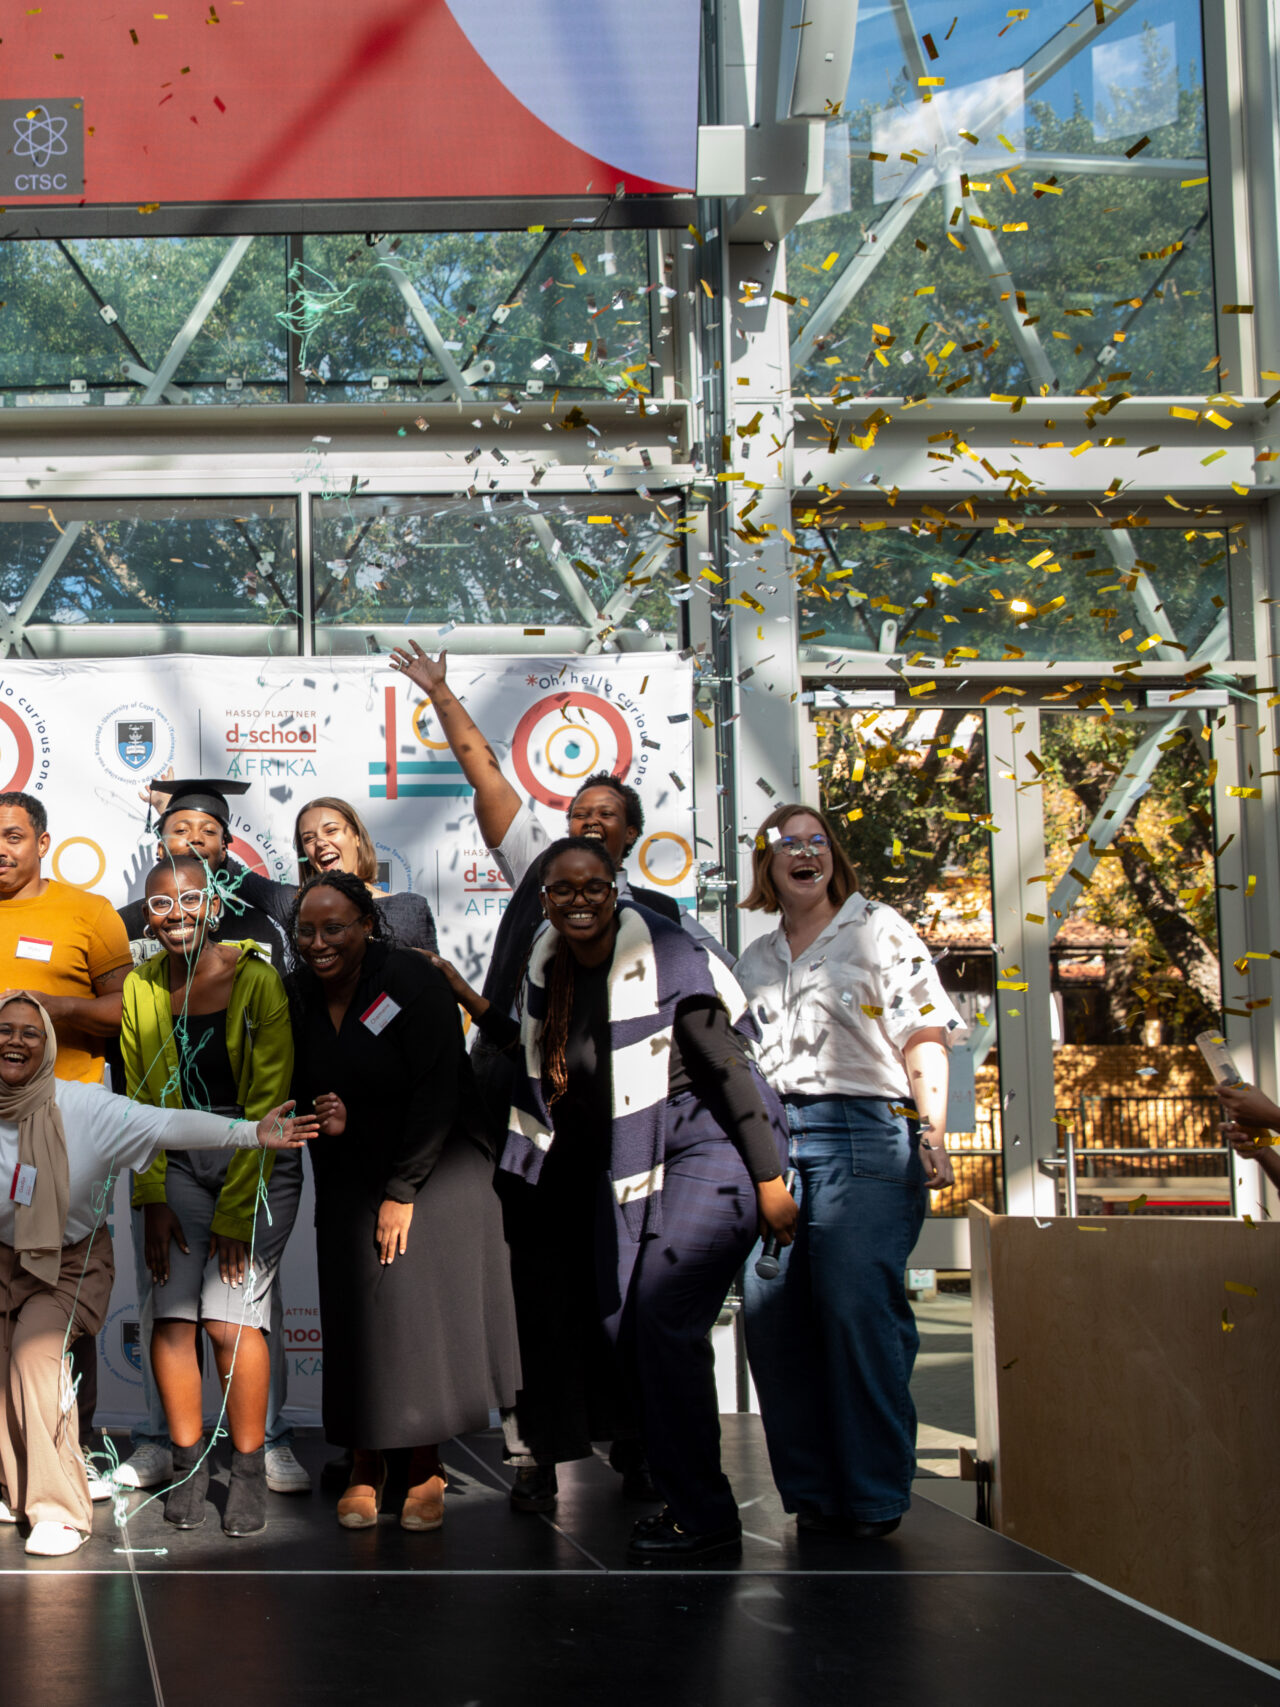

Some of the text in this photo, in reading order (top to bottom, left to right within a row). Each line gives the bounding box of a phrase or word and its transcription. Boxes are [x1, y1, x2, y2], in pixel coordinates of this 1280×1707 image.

[14, 173, 68, 191] CTSC
[225, 709, 317, 719] HASSO PLATTNER
[225, 722, 317, 744] d-school
[570, 671, 613, 693] hello
[633, 754, 649, 786] one
[18, 697, 51, 754] curious
[35, 759, 50, 790] one
[226, 758, 318, 777] AFRIKA
[228, 813, 251, 833] llo
[463, 849, 490, 857] HASS
[285, 1307, 320, 1317] ATTNE
